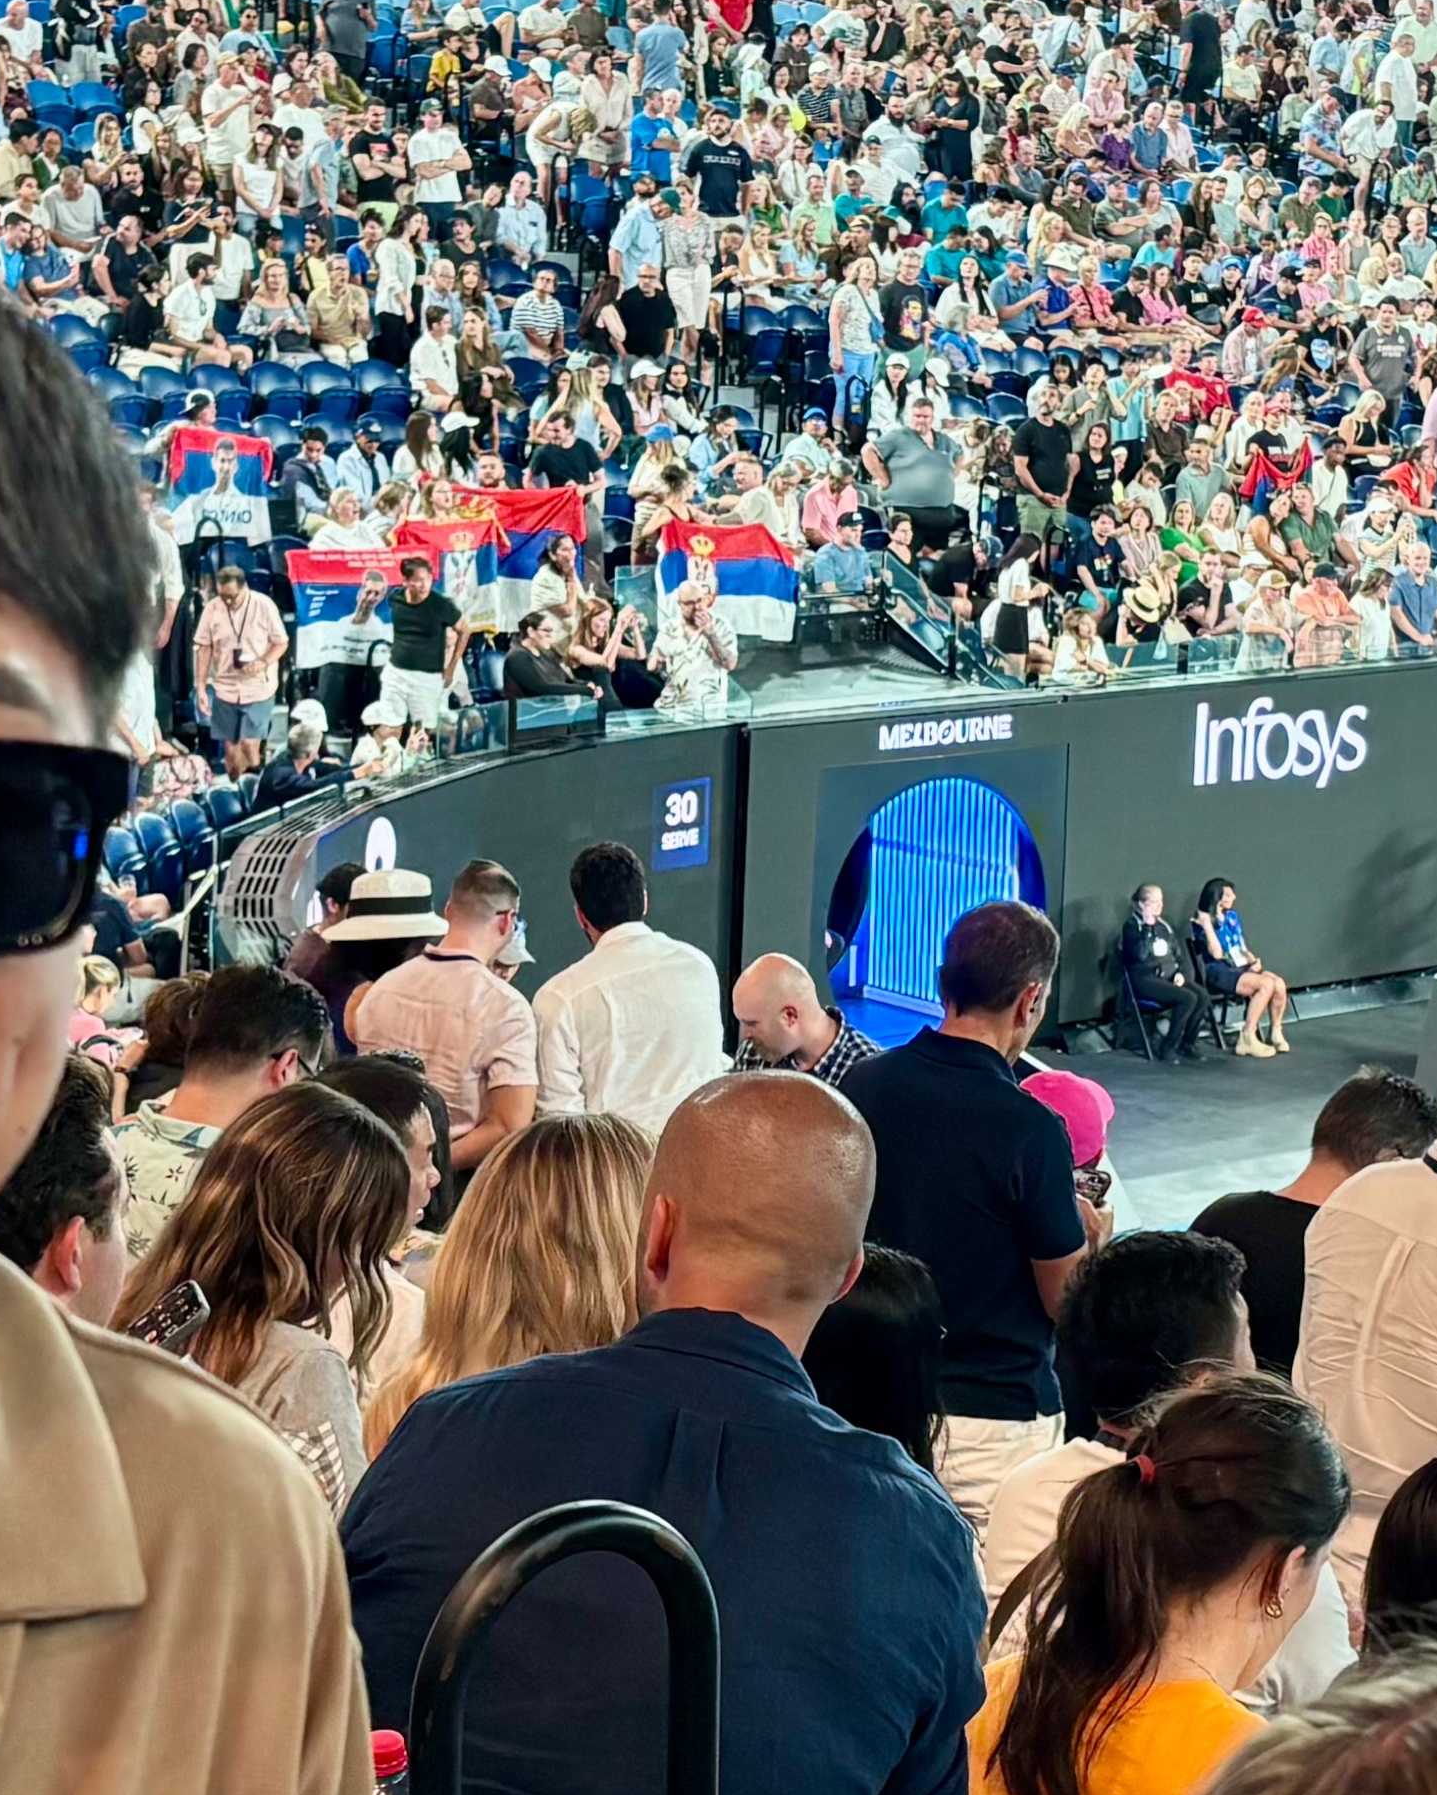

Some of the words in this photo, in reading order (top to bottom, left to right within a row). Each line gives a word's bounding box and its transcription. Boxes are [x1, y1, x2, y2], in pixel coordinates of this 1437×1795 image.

[878, 713, 1013, 751] MELBOURNE
[1194, 697, 1368, 789] Infosys
[664, 790, 698, 826] 30
[661, 827, 699, 851] SERVE
